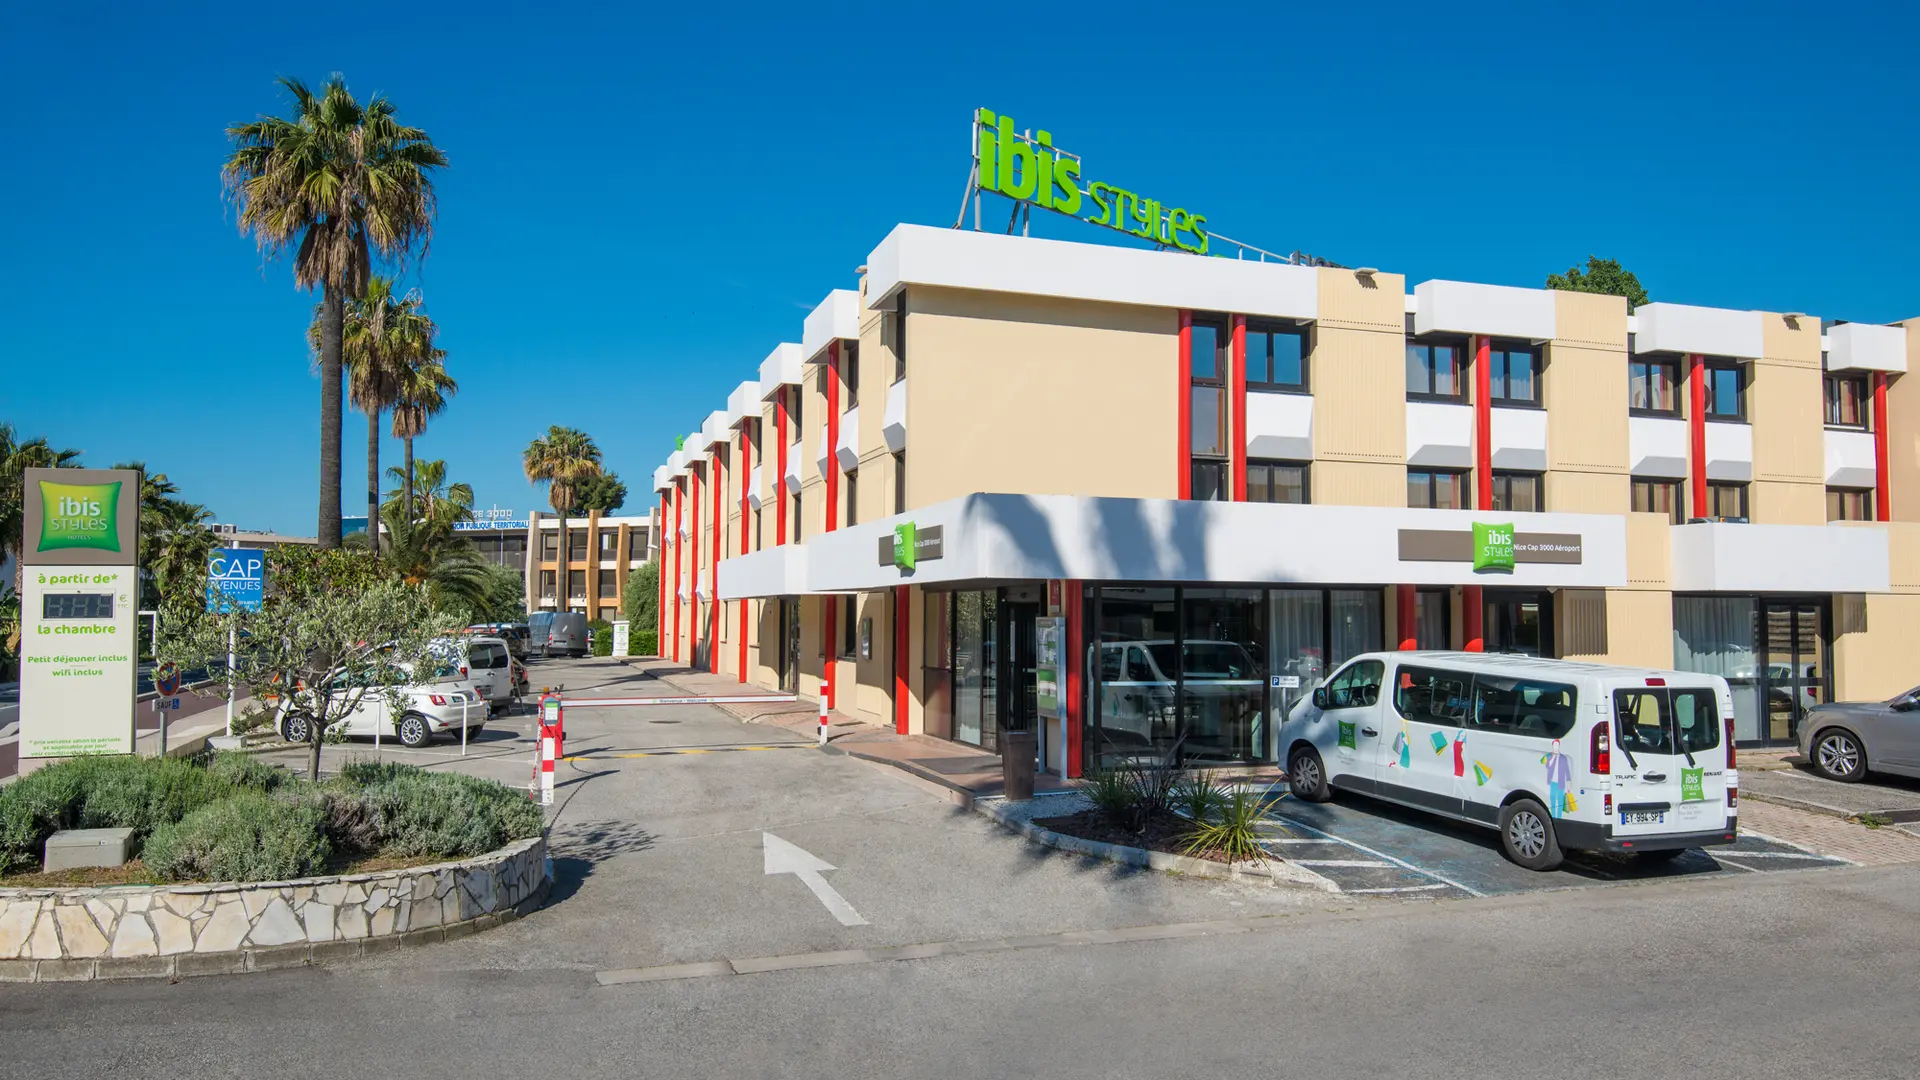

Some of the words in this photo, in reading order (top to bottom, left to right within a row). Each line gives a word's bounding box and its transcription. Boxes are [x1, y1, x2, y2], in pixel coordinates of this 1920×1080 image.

[979, 107, 1081, 215] ibis
[59, 496, 101, 516] ibis
[494, 520, 529, 530] TERRITORIAL
[1488, 530, 1511, 545] ibis
[210, 558, 261, 578] CAP
[38, 574, 46, 584] à
[50, 574, 89, 585] partir
[38, 624, 51, 634] la
[54, 624, 116, 634] chambre
[53, 655, 96, 664] déjeuner
[74, 668, 103, 676] inclus
[157, 701, 172, 710] SAUF
[1686, 774, 1698, 784] ibis
